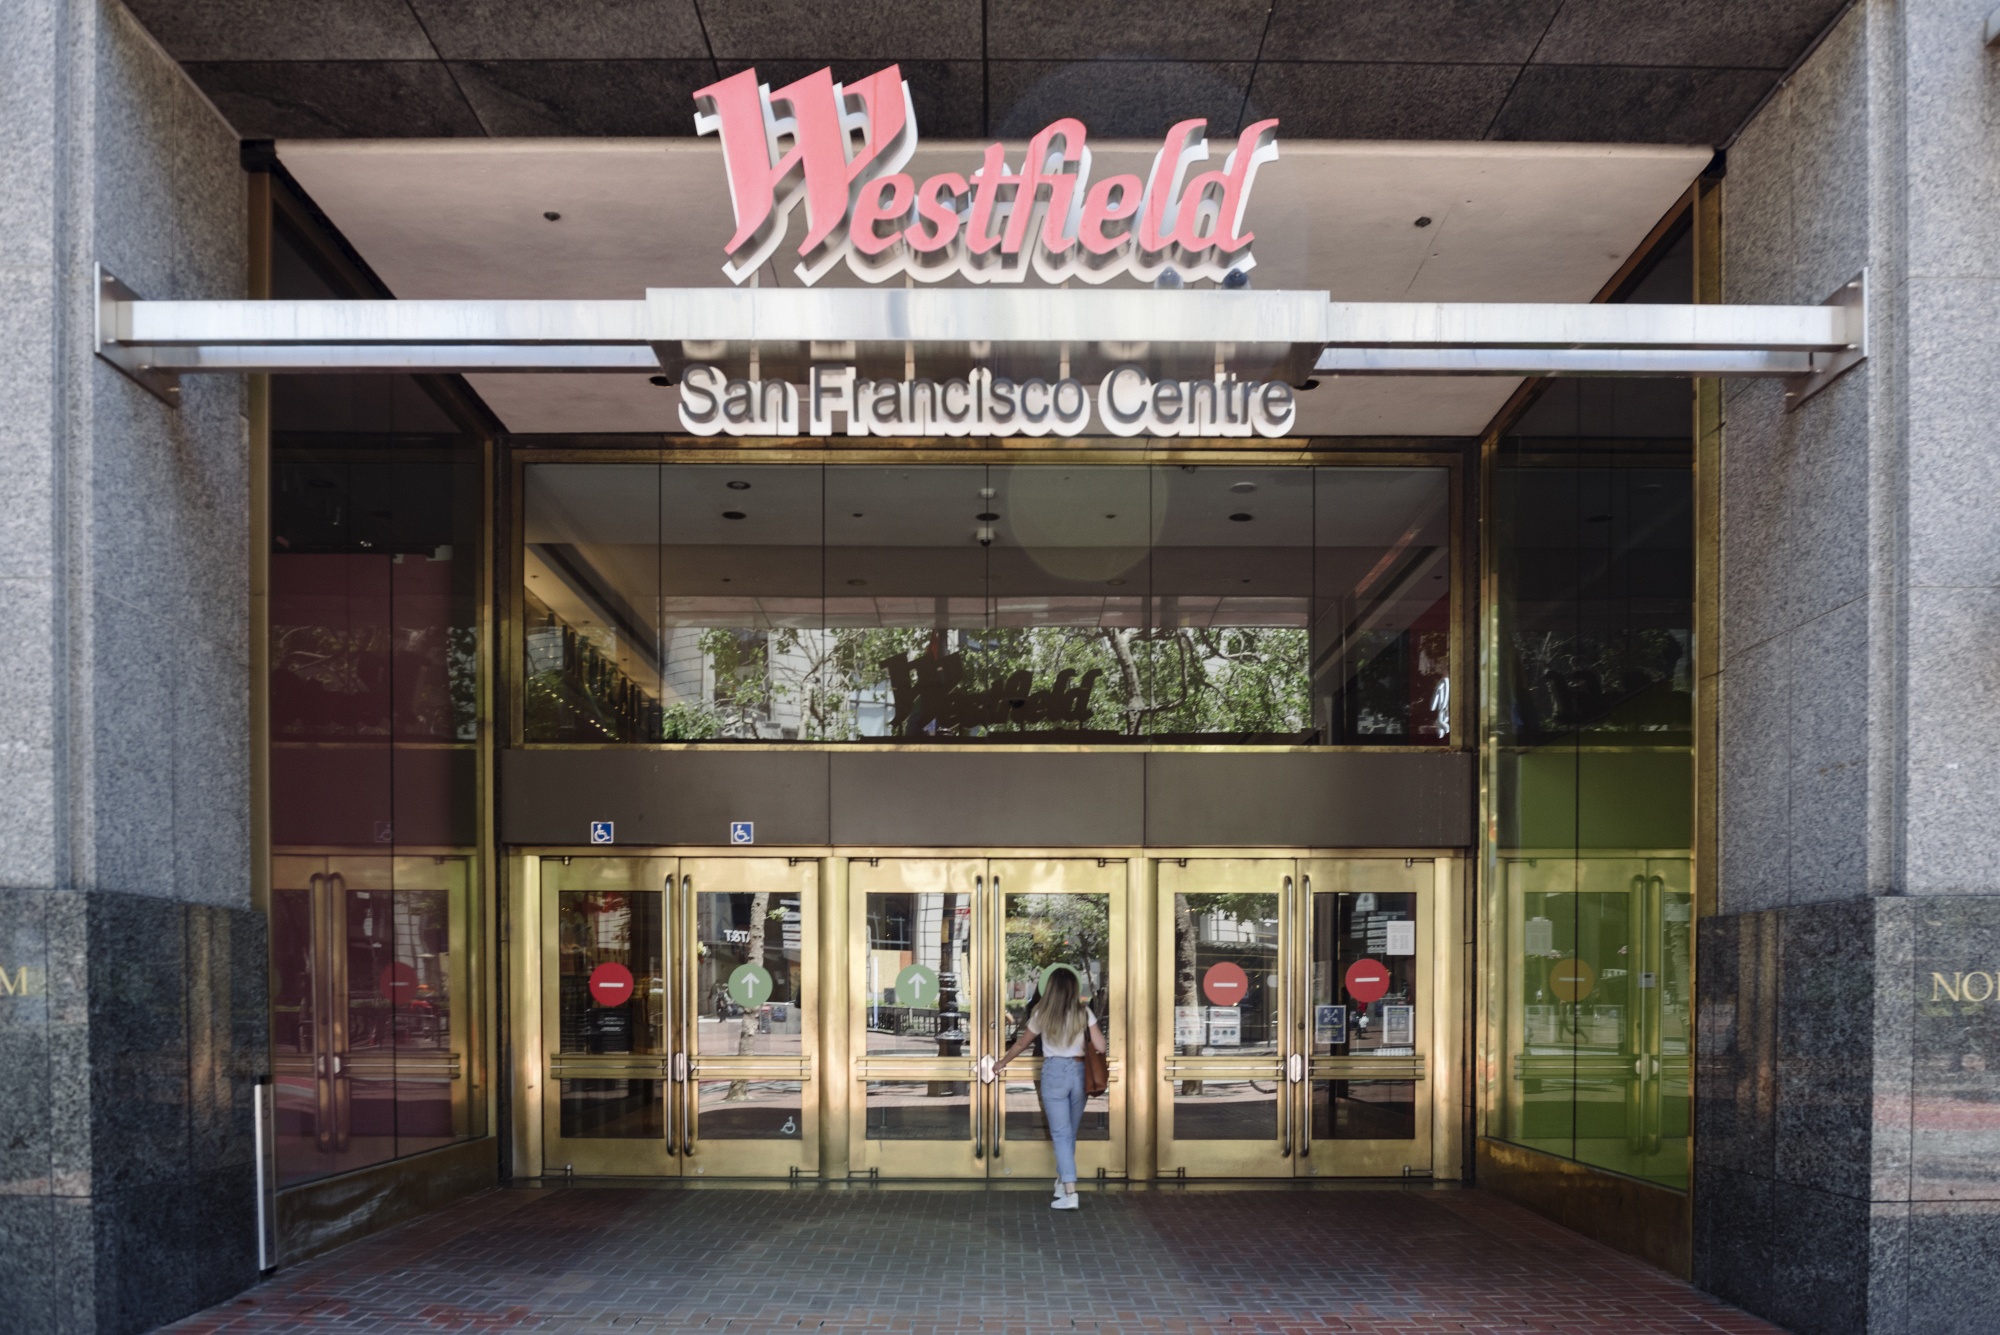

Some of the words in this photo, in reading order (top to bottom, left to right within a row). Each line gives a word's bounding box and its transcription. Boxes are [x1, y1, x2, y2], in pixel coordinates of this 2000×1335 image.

[693, 63, 1279, 268] Westfield
[680, 363, 795, 432] San
[810, 363, 1086, 432] Francisco
[1100, 364, 1294, 433] Centre
